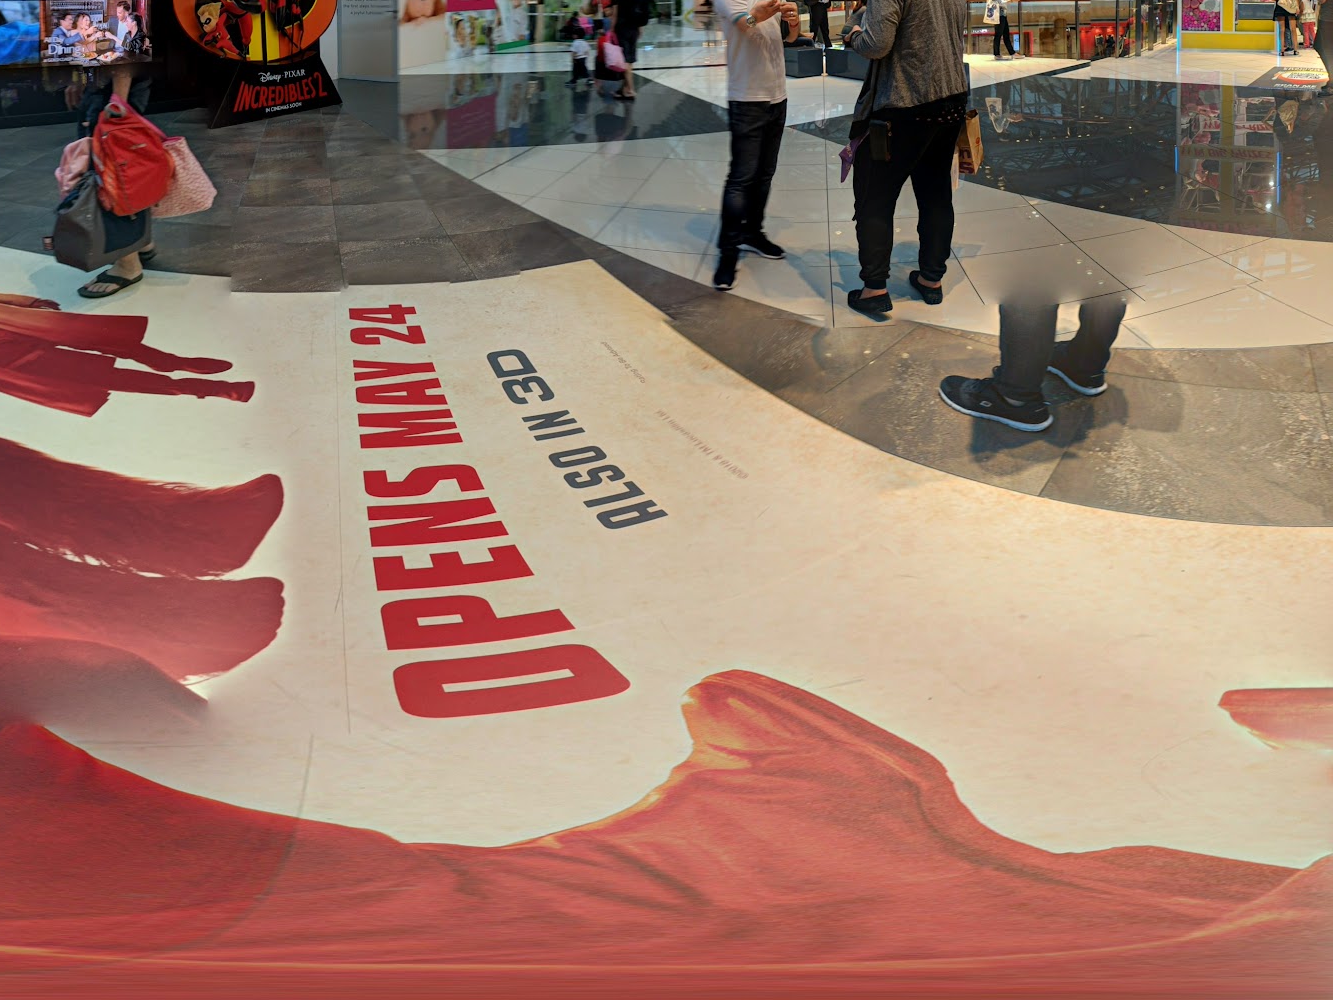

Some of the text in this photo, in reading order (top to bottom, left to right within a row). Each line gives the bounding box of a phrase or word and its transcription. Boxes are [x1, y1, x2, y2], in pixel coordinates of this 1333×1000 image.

[233, 71, 328, 113] INCREDIBLES 2
[284, 69, 306, 79] PIXAR
[486, 348, 669, 530] ALSO IN 3D
[348, 304, 632, 719] OPENS MAY 24
